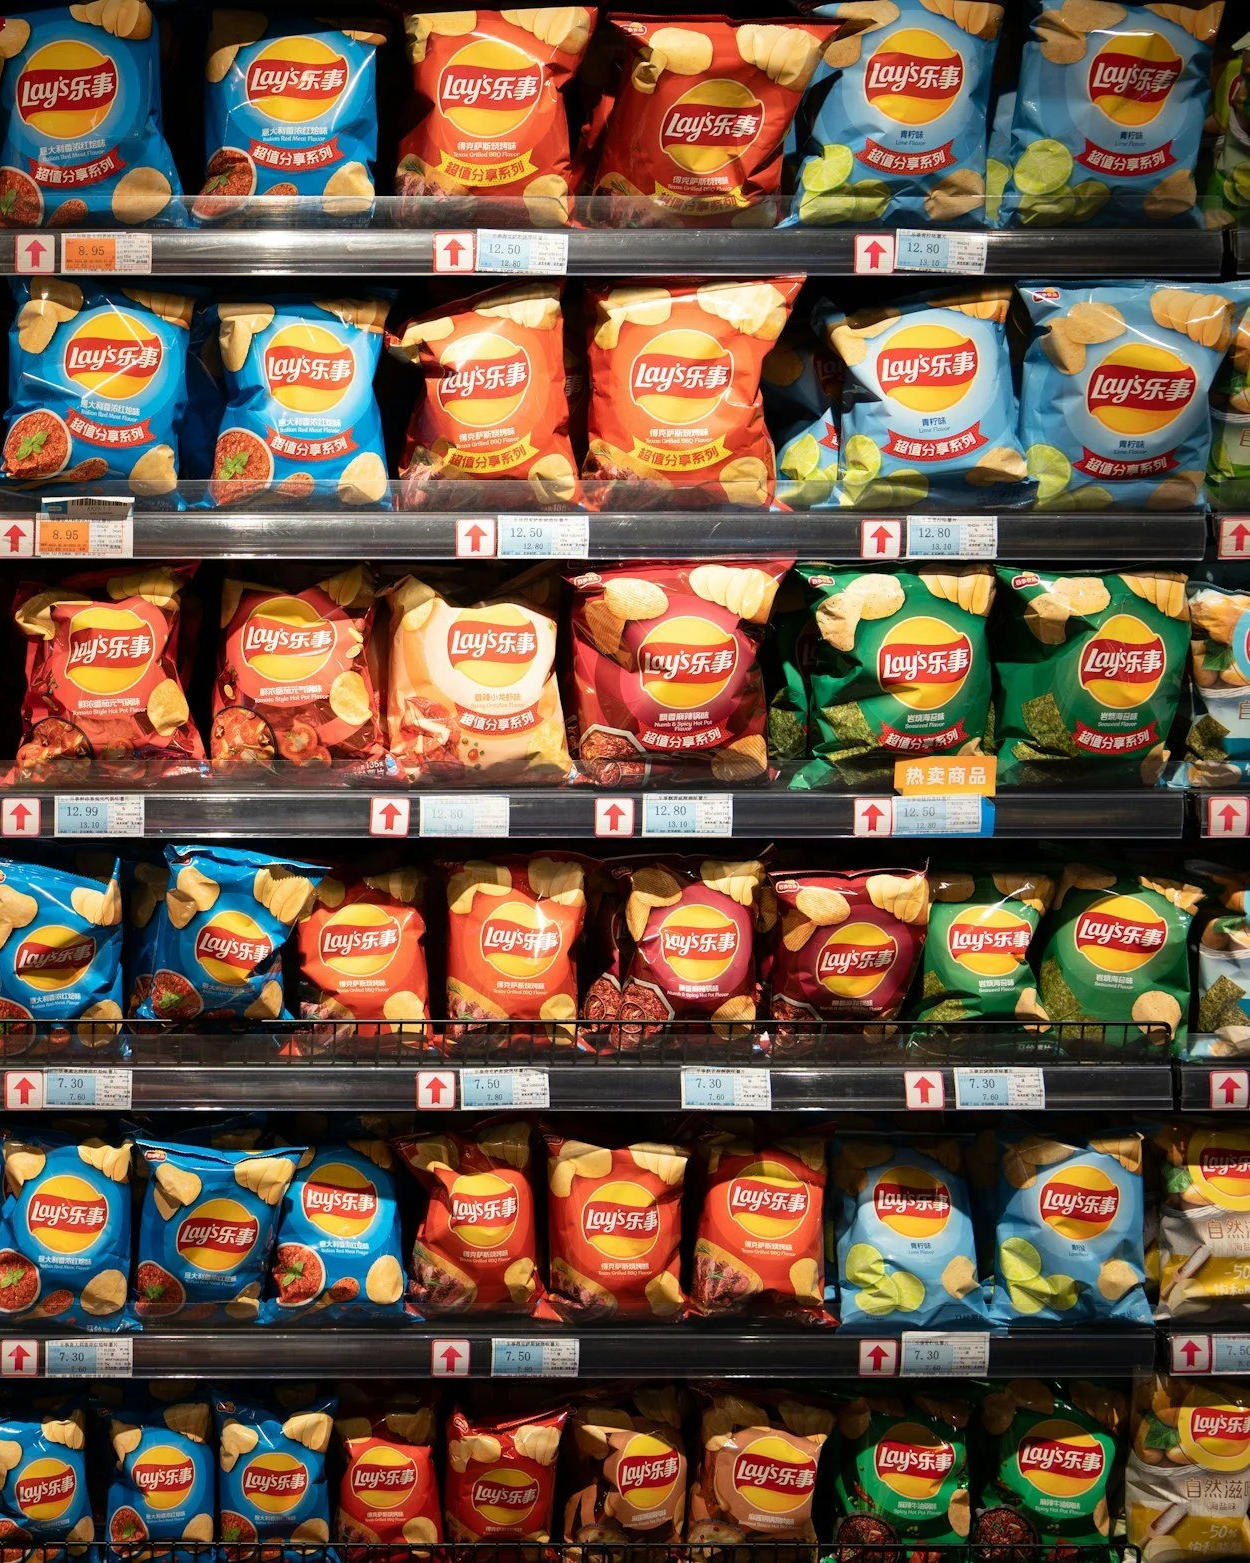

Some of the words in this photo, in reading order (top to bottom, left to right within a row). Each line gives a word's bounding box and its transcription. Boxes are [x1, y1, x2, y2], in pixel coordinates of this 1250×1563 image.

[252, 145, 333, 166] 超值分享系列
[868, 148, 946, 170] 超值分享系列
[1087, 149, 1165, 172] 超值分享系列
[35, 160, 115, 184] 超值分享系列
[444, 160, 525, 182] 超值分享系列
[78, 245, 105, 256] 8.95
[488, 243, 521, 255] 12.50
[907, 242, 940, 254] 12.80
[70, 419, 144, 443] 超值分享系列
[270, 437, 348, 456] 超值分享系列
[894, 434, 976, 456] 超值分享系列
[450, 446, 527, 468] 超值分享系列
[638, 446, 720, 466] 超值分享系列
[1086, 459, 1168, 476] 超值分享系列
[52, 529, 79, 540] 8.95
[510, 527, 542, 539] 12.50
[919, 528, 950, 539] 12.80
[460, 711, 534, 731] 超值分享系列
[643, 727, 722, 748] 超值分享系列
[885, 728, 958, 749] 超值分享系列
[1077, 730, 1150, 750] 超值分享系列
[905, 766, 987, 785] 热卖商品
[67, 806, 99, 817] 12.99
[431, 809, 463, 820] 12.80
[654, 806, 686, 817] 12.80
[903, 806, 935, 817] 12.50
[58, 1078, 83, 1089] 7.30
[475, 1079, 500, 1089] 7.50
[696, 1078, 722, 1089] 7.30
[970, 1078, 995, 1089] 7.30
[59, 1352, 84, 1362] 7.30
[506, 1351, 531, 1361] 7.50
[914, 1350, 939, 1360] 7.30
